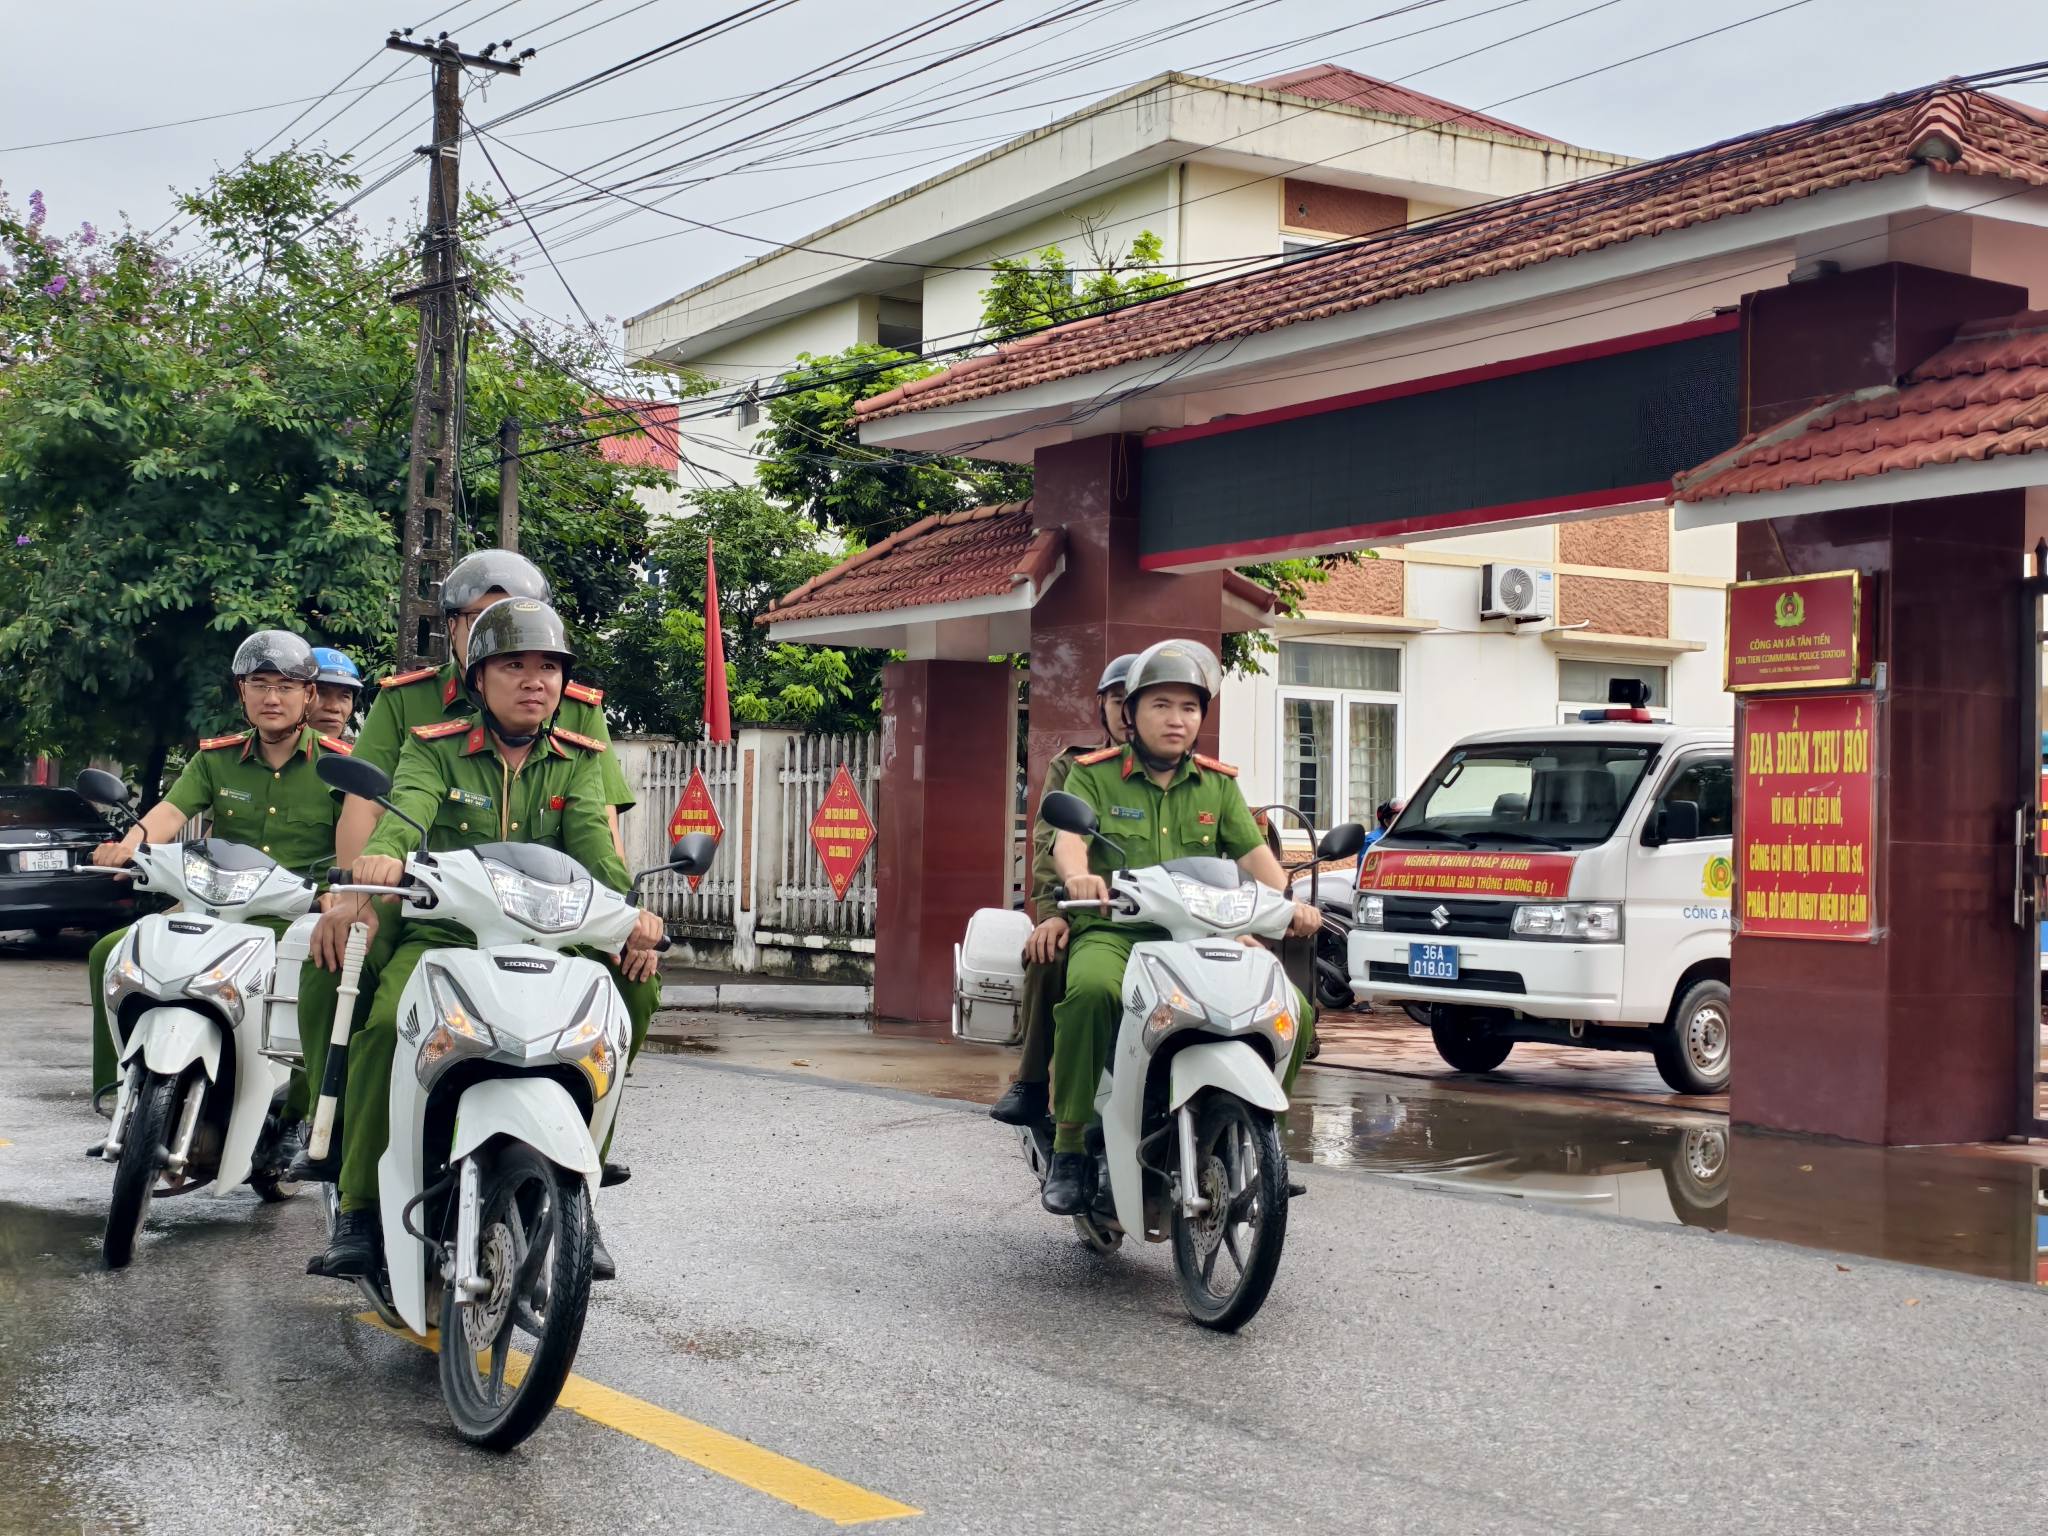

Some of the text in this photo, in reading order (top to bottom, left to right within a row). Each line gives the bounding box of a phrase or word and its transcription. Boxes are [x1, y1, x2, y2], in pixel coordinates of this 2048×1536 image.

[1749, 632, 1831, 650] CÔNG AN XÃ TÂN TIẾN
[1735, 649, 1846, 665] TAN TIEN COMMUNAL POLICE STATION
[1749, 731, 1774, 787] ĐỊA
[1776, 705, 1810, 775] ĐIỂM
[1812, 730, 1840, 774] THU
[1404, 853, 1440, 867] NGHIÊM
[1500, 855, 1531, 871] HÀNH
[1750, 838, 1770, 872] CÔNG
[1425, 874, 1436, 887] AN
[1436, 872, 1456, 888] TOÀN
[1456, 874, 1475, 889] GIAO
[1476, 874, 1502, 890] THÔNG
[1534, 878, 1548, 896] BỘ
[1683, 904, 1732, 920] CÔNG A
[171, 924, 202, 932] HONDA
[1422, 945, 1444, 960] 36A
[504, 961, 548, 970] HONDA
[1414, 960, 1452, 977] 018.03
